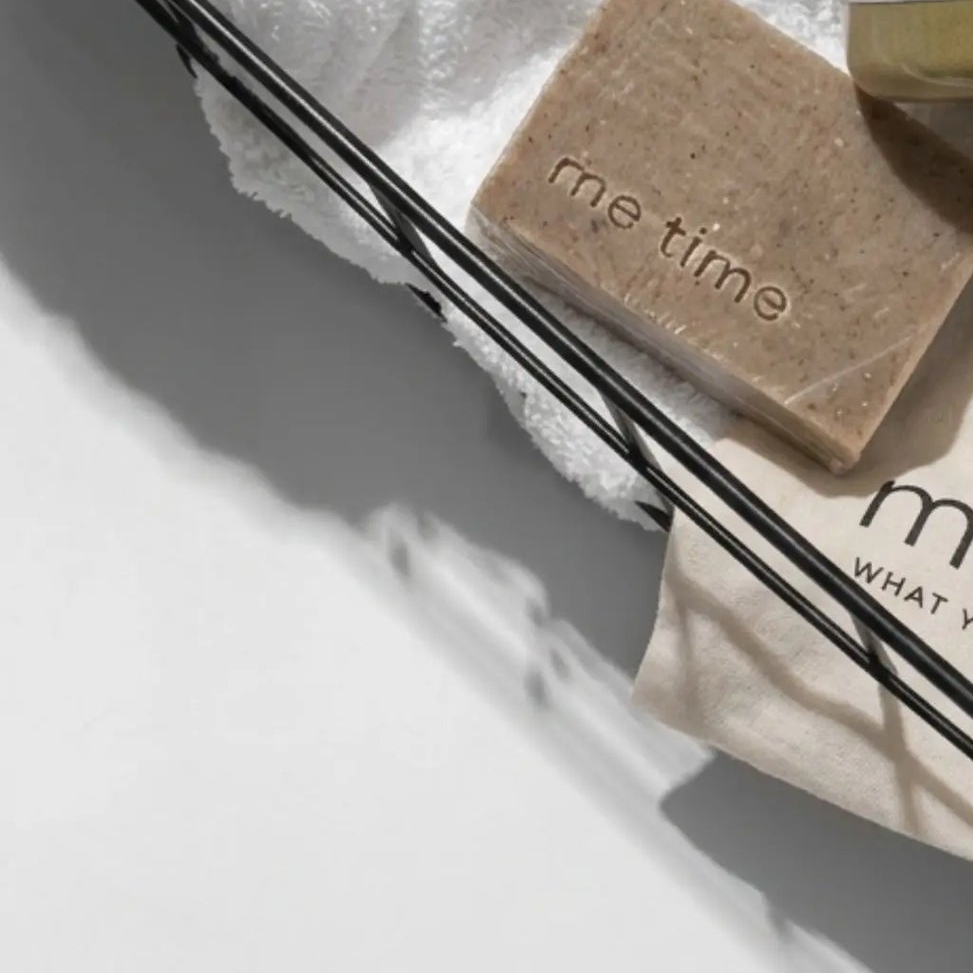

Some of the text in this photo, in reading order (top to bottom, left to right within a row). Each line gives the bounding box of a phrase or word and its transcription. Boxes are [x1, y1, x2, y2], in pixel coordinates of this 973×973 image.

[548, 157, 788, 321] me time
[852, 556, 948, 616] WHAT
